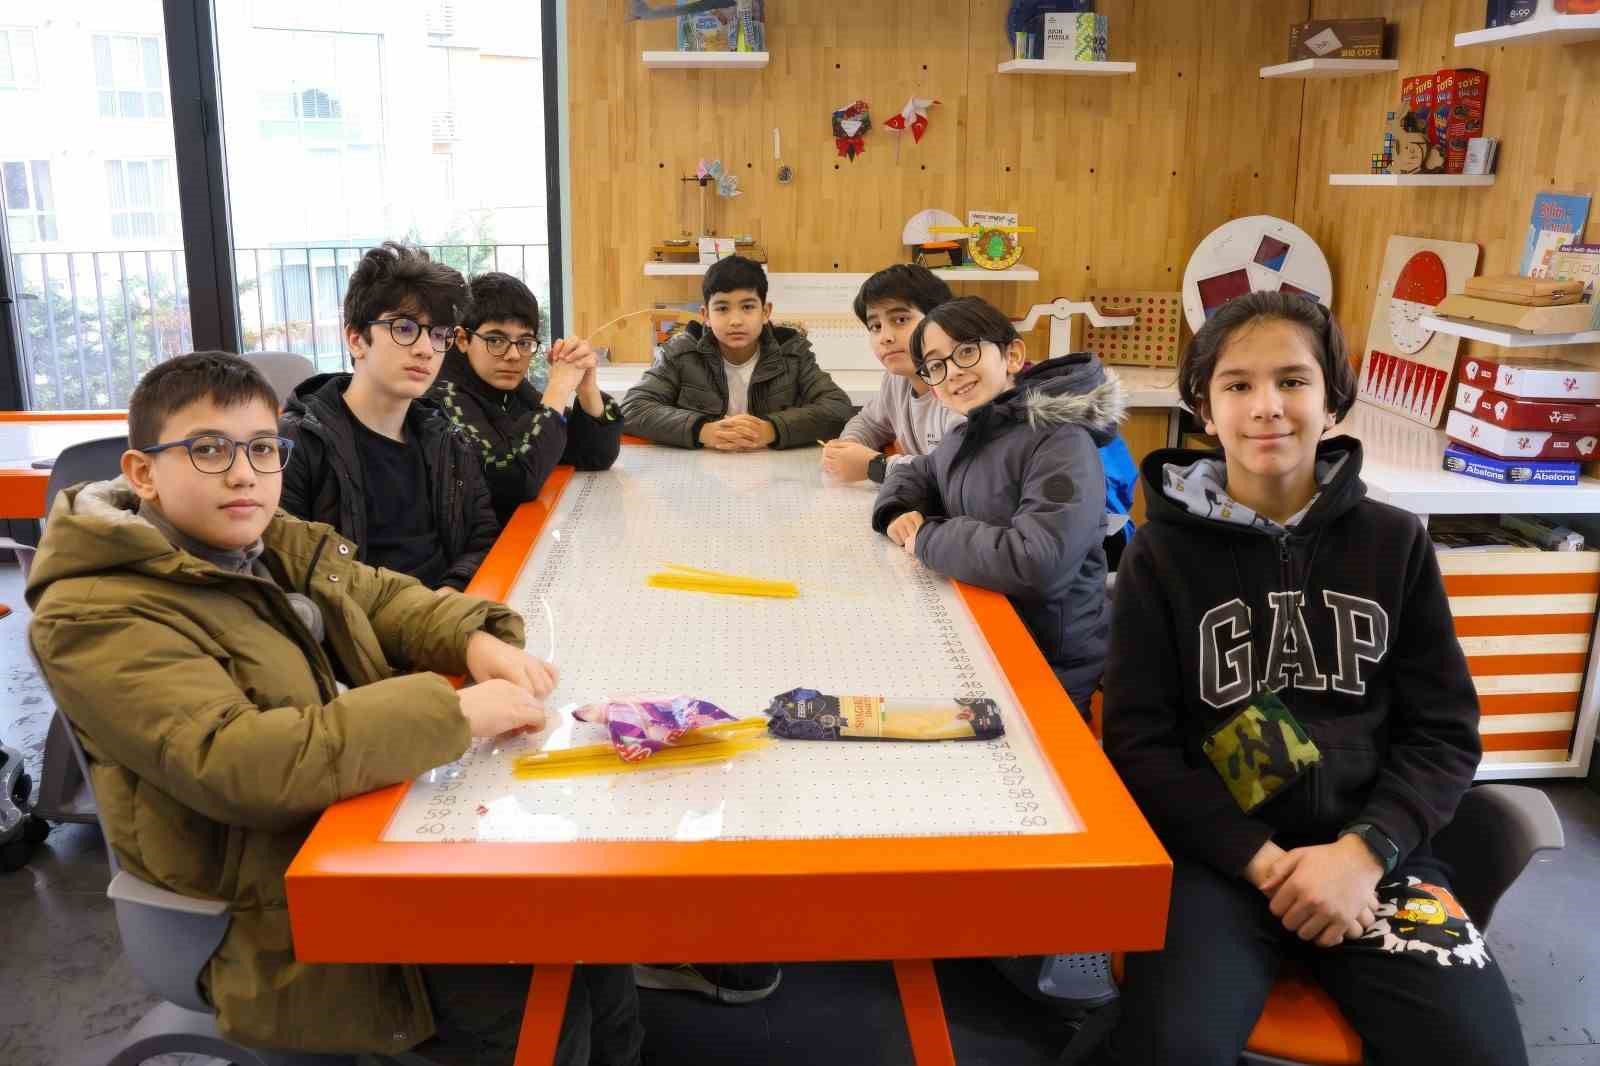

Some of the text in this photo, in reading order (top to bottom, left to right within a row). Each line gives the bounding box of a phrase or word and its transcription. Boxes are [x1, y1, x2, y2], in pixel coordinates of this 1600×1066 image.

[1466, 465, 1504, 480] Abalone
[1533, 472, 1576, 481] Abalone
[1200, 590, 1389, 708] GAP
[965, 690, 987, 698] 49
[986, 742, 1010, 750] 54
[992, 752, 1017, 761] 55
[998, 763, 1023, 774] 56
[1002, 775, 1025, 785] 57
[1008, 788, 1034, 799] 58
[429, 795, 456, 806] 58
[1016, 802, 1039, 813] 59
[423, 808, 451, 820] 59
[1020, 815, 1048, 827] 60
[416, 823, 445, 834] 60
